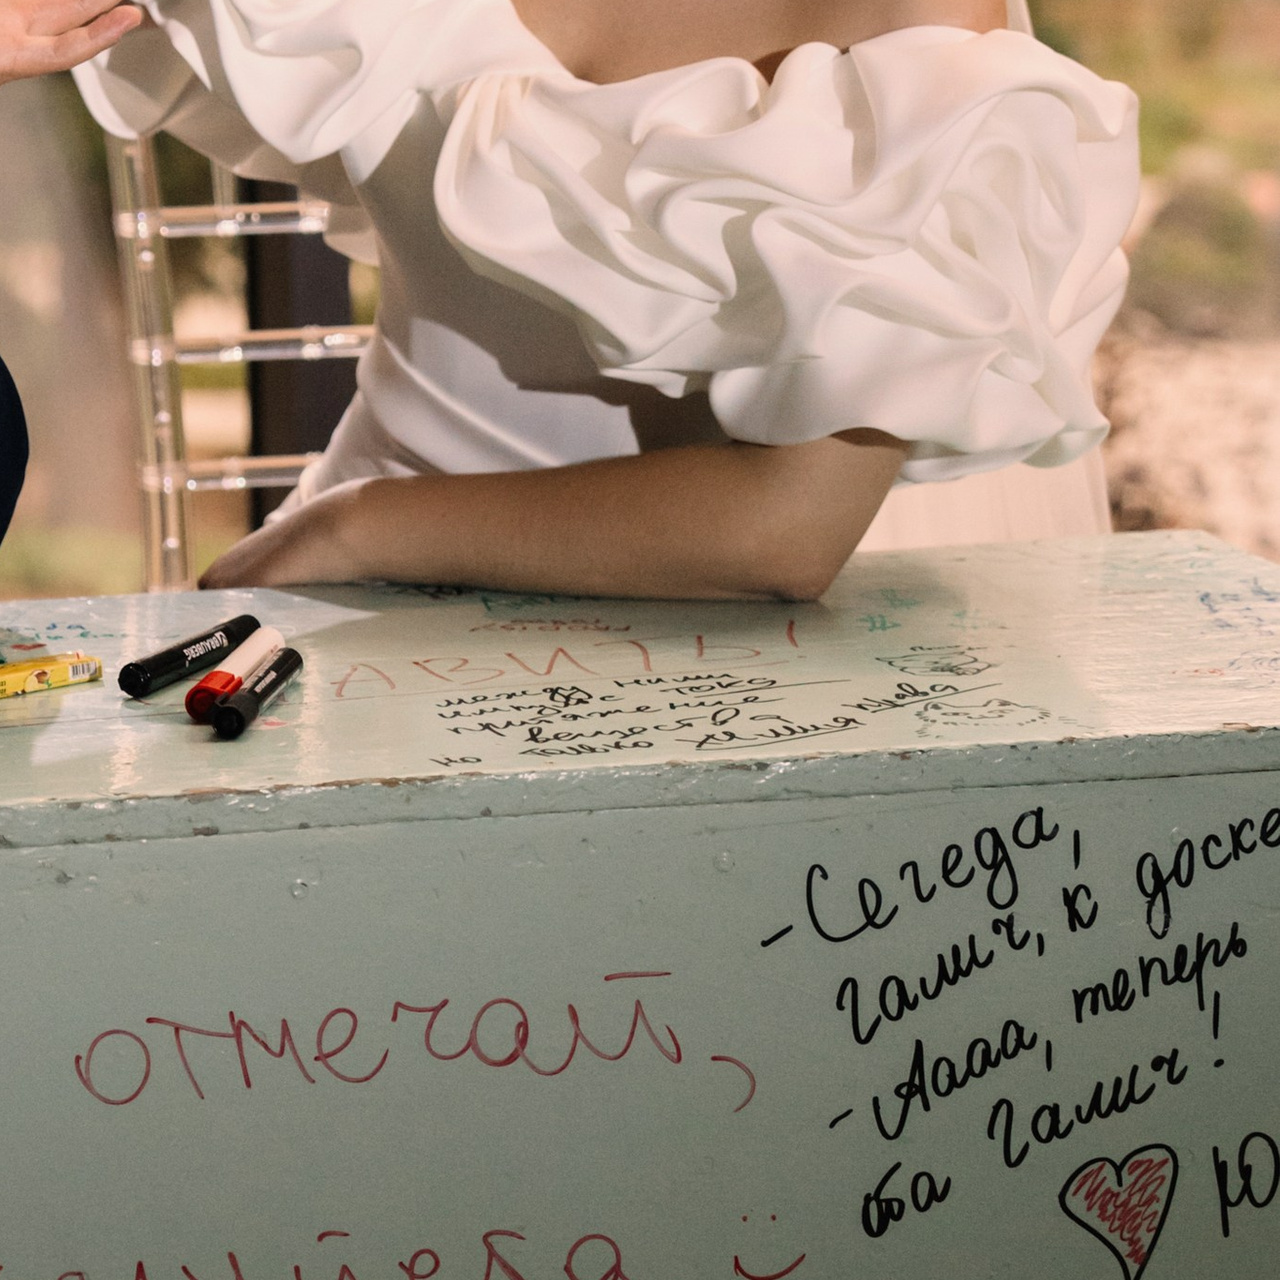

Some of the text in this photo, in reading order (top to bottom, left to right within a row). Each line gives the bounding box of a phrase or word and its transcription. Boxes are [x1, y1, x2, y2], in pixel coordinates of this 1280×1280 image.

[183, 636, 223, 661] BRAUBERG
[518, 740, 655, 758] только
[1136, 807, 1280, 940] доске
[1072, 921, 1248, 1024] теперь
[75, 971, 756, 1113] отмечай,
[860, 1161, 952, 1239] оба
